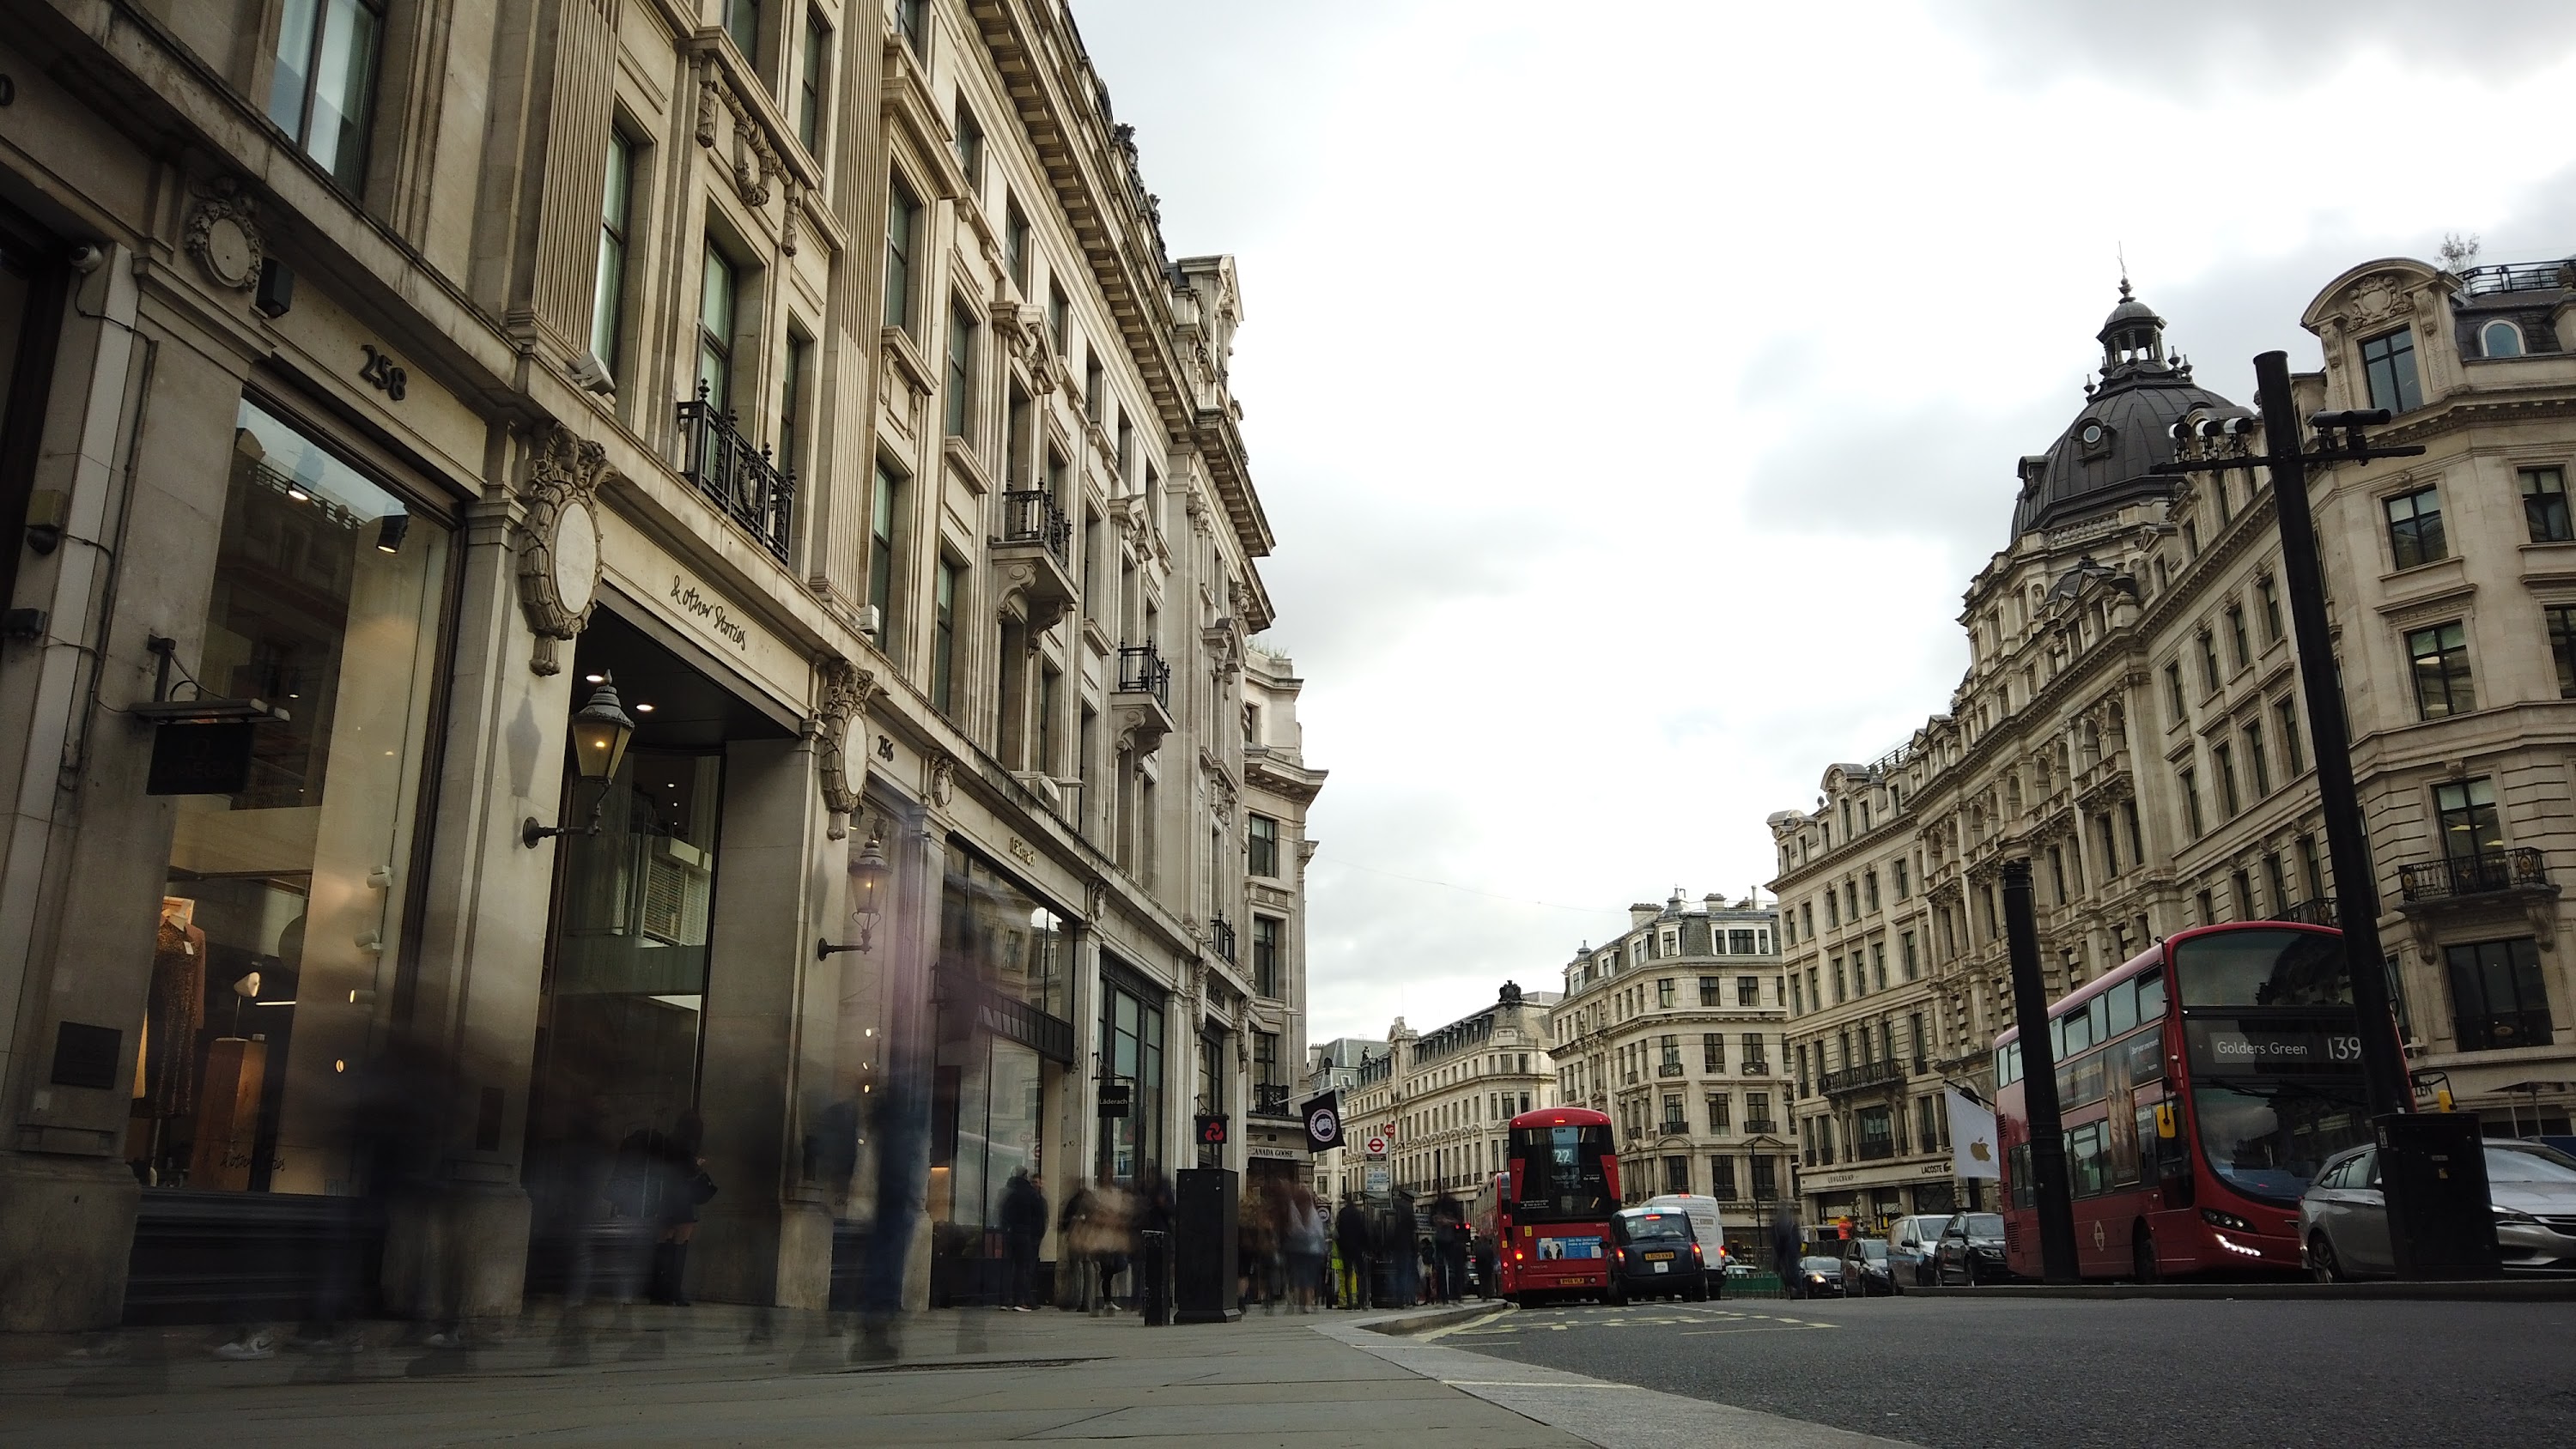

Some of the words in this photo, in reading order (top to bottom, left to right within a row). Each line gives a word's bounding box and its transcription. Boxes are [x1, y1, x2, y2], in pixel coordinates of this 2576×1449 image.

[359, 344, 407, 401] 258
[671, 574, 681, 605] &
[714, 605, 745, 651] Stories
[878, 735, 894, 762] 256
[2217, 1041, 2266, 1054] Golders
[2269, 1041, 2308, 1055] Green
[2328, 1036, 2362, 1060] 139
[1554, 1149, 1571, 1163] 22
[1921, 1165, 1942, 1174] LACOSTE
